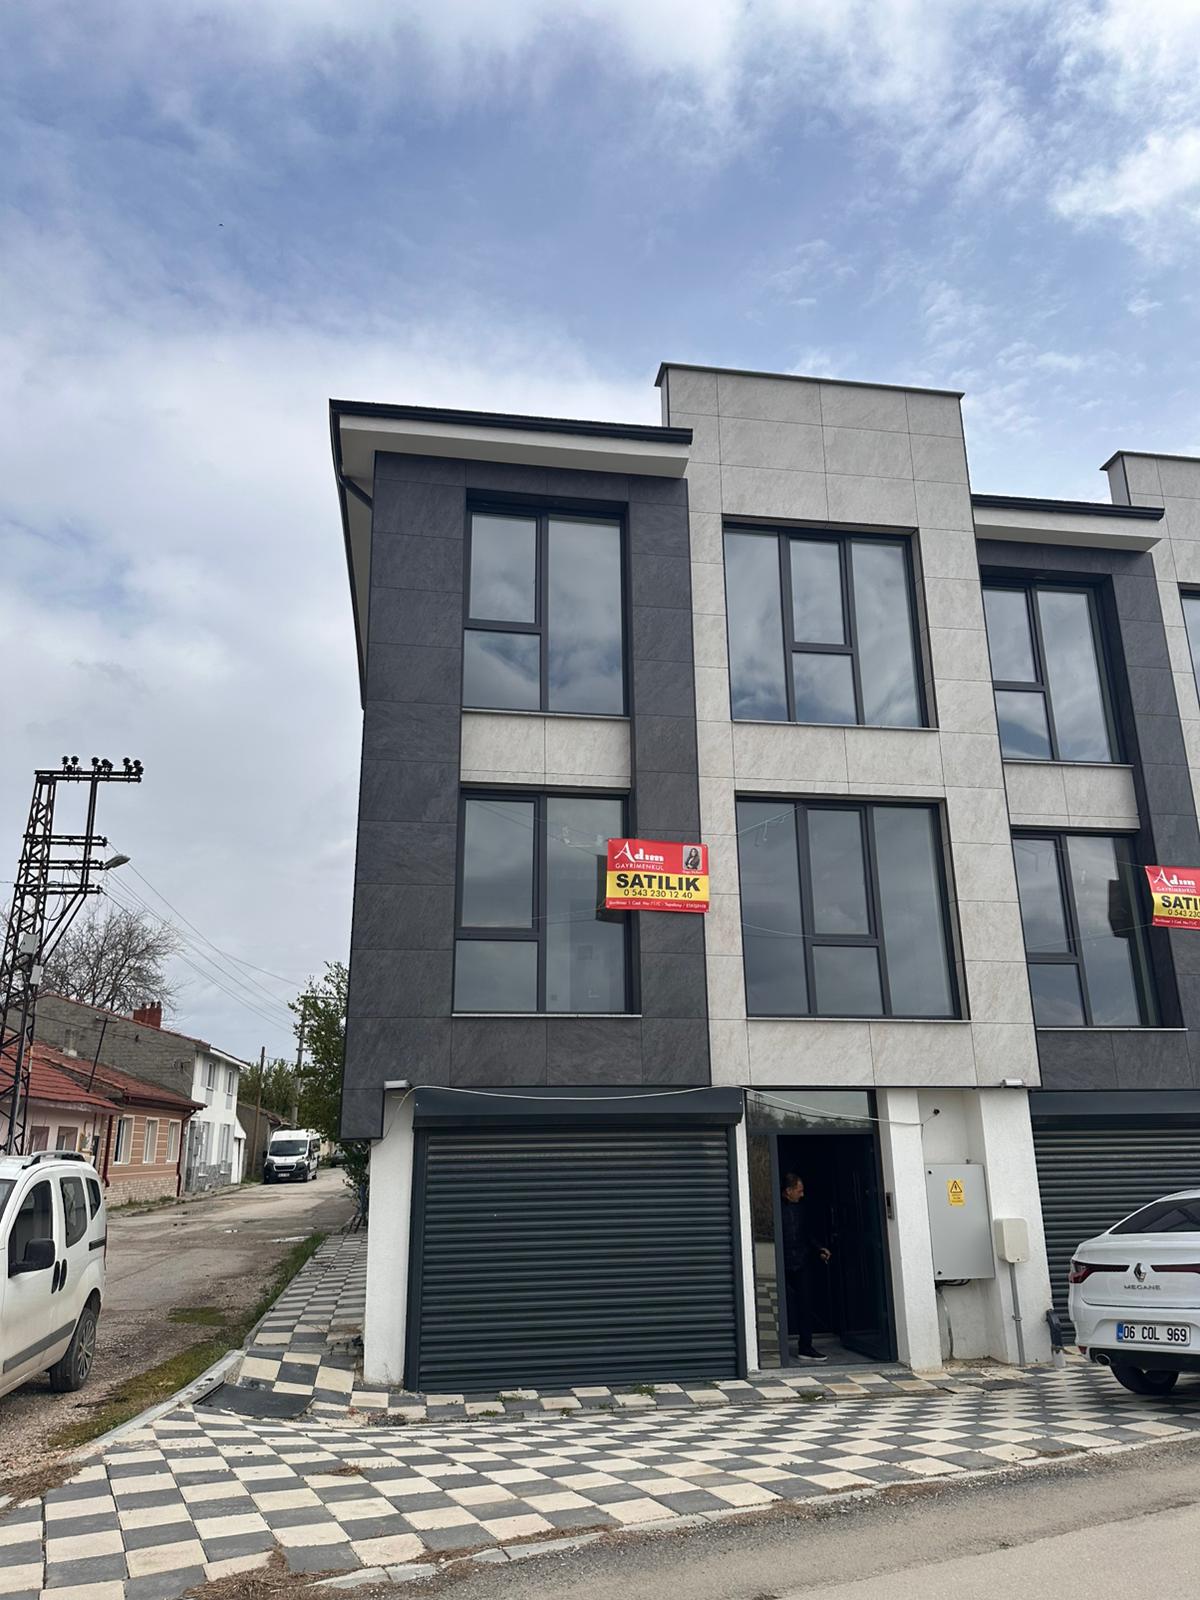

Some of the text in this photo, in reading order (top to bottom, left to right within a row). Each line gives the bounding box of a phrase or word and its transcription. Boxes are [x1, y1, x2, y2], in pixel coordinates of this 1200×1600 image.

[616, 873, 700, 892] SATILIK
[632, 889, 648, 897] 543
[650, 890, 666, 898] 230
[1161, 895, 1200, 910] SATI
[1124, 1325, 1187, 1342] 06 COL 969
